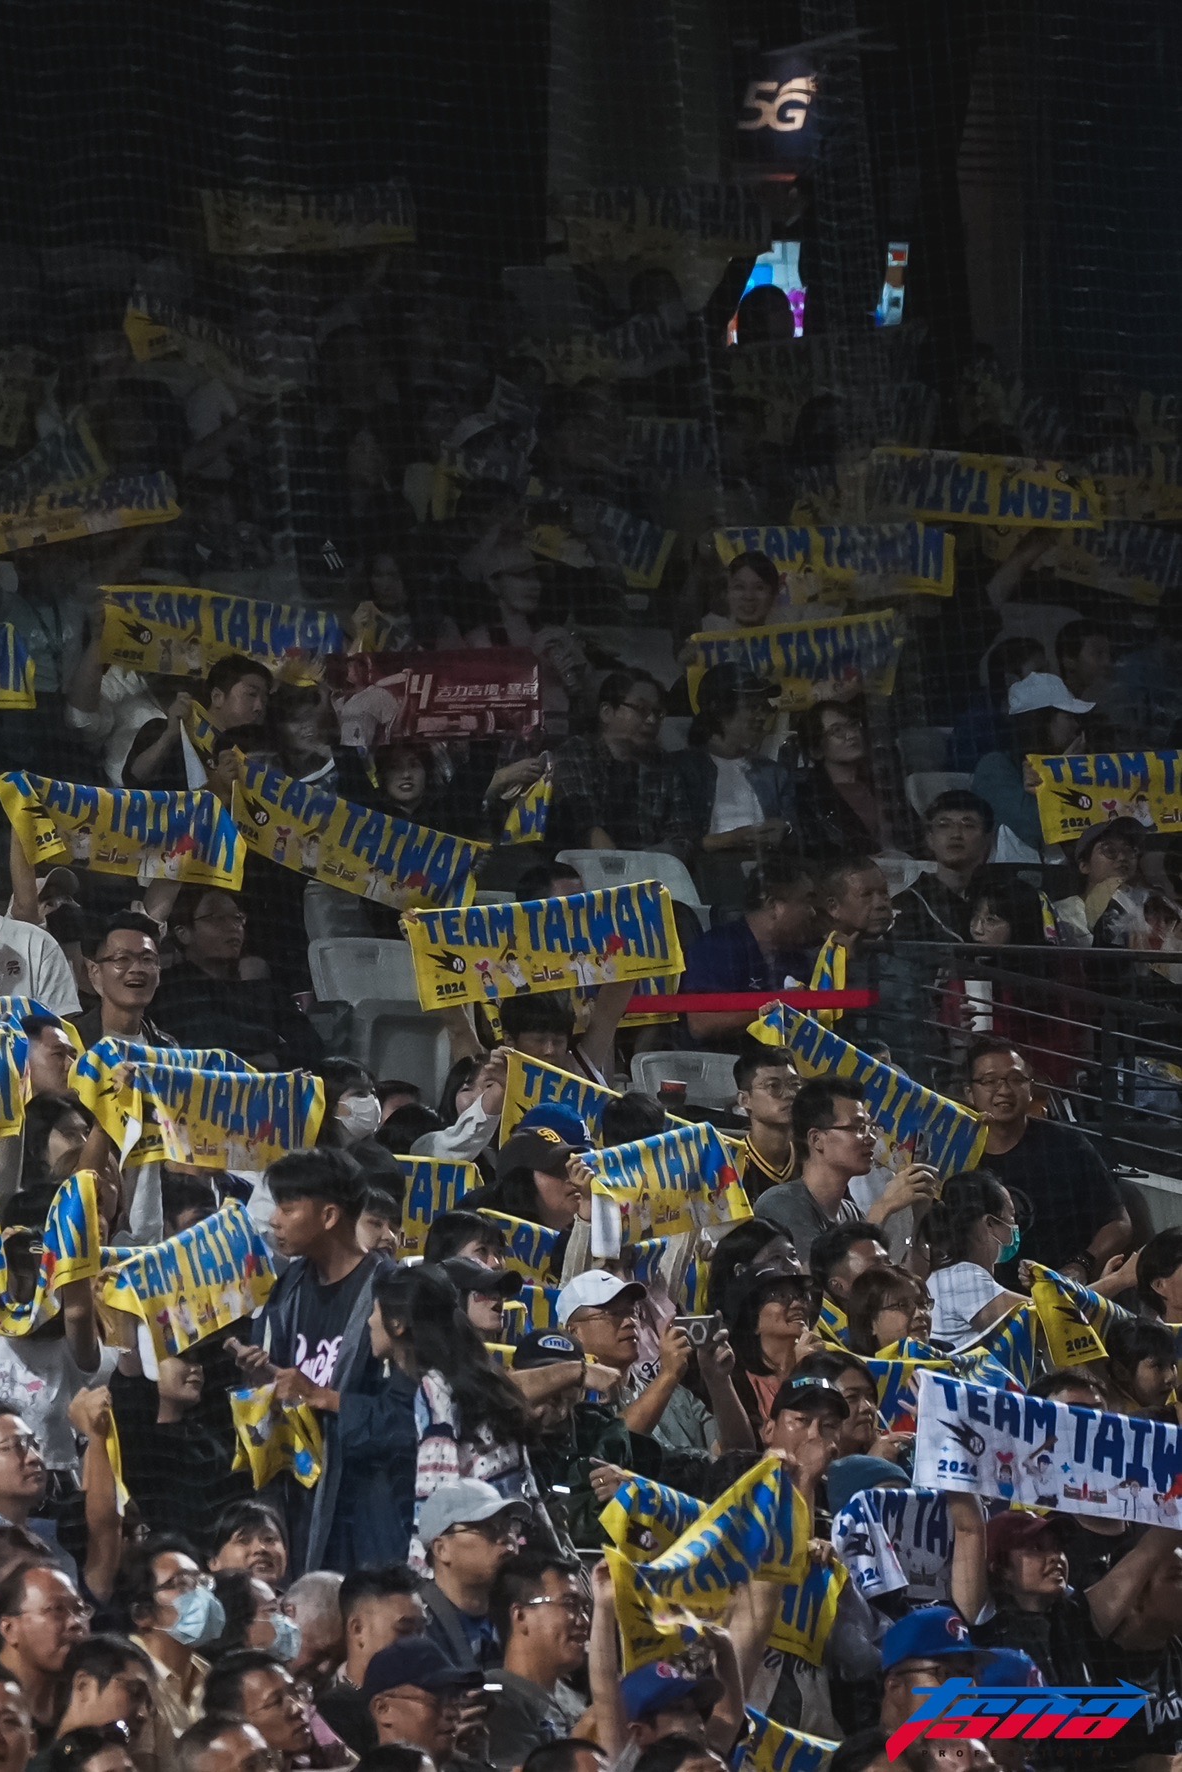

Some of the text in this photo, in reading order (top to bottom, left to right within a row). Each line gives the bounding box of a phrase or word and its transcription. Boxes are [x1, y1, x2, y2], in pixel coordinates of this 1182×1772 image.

[1042, 751, 1151, 793] TEAM
[420, 882, 669, 960] TEAM TAIWAN
[933, 1376, 1058, 1453] TEAM
[937, 1458, 978, 1477] 2024
